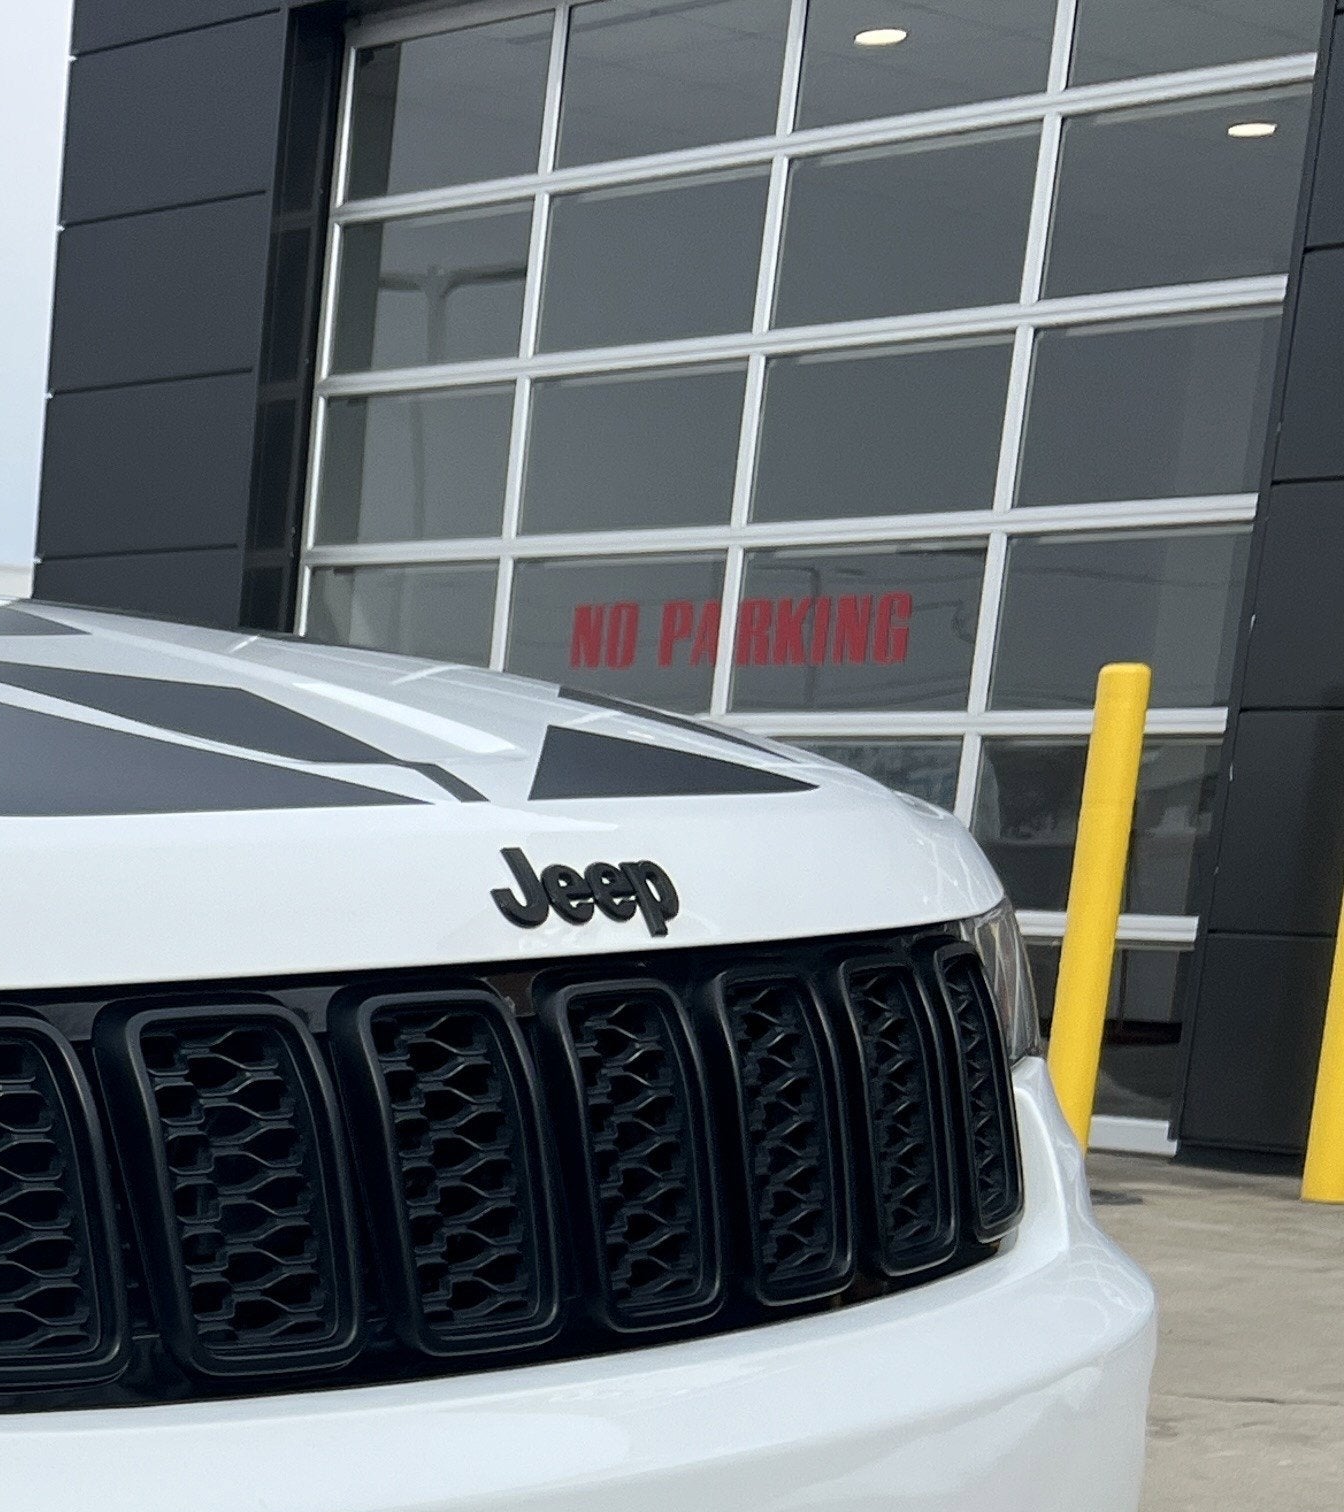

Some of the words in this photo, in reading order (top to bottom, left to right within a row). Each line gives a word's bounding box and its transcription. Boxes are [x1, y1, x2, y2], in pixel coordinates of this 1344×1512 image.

[569, 601, 639, 671] NO
[658, 592, 913, 670] PARKING
[490, 847, 680, 937] Jeep
